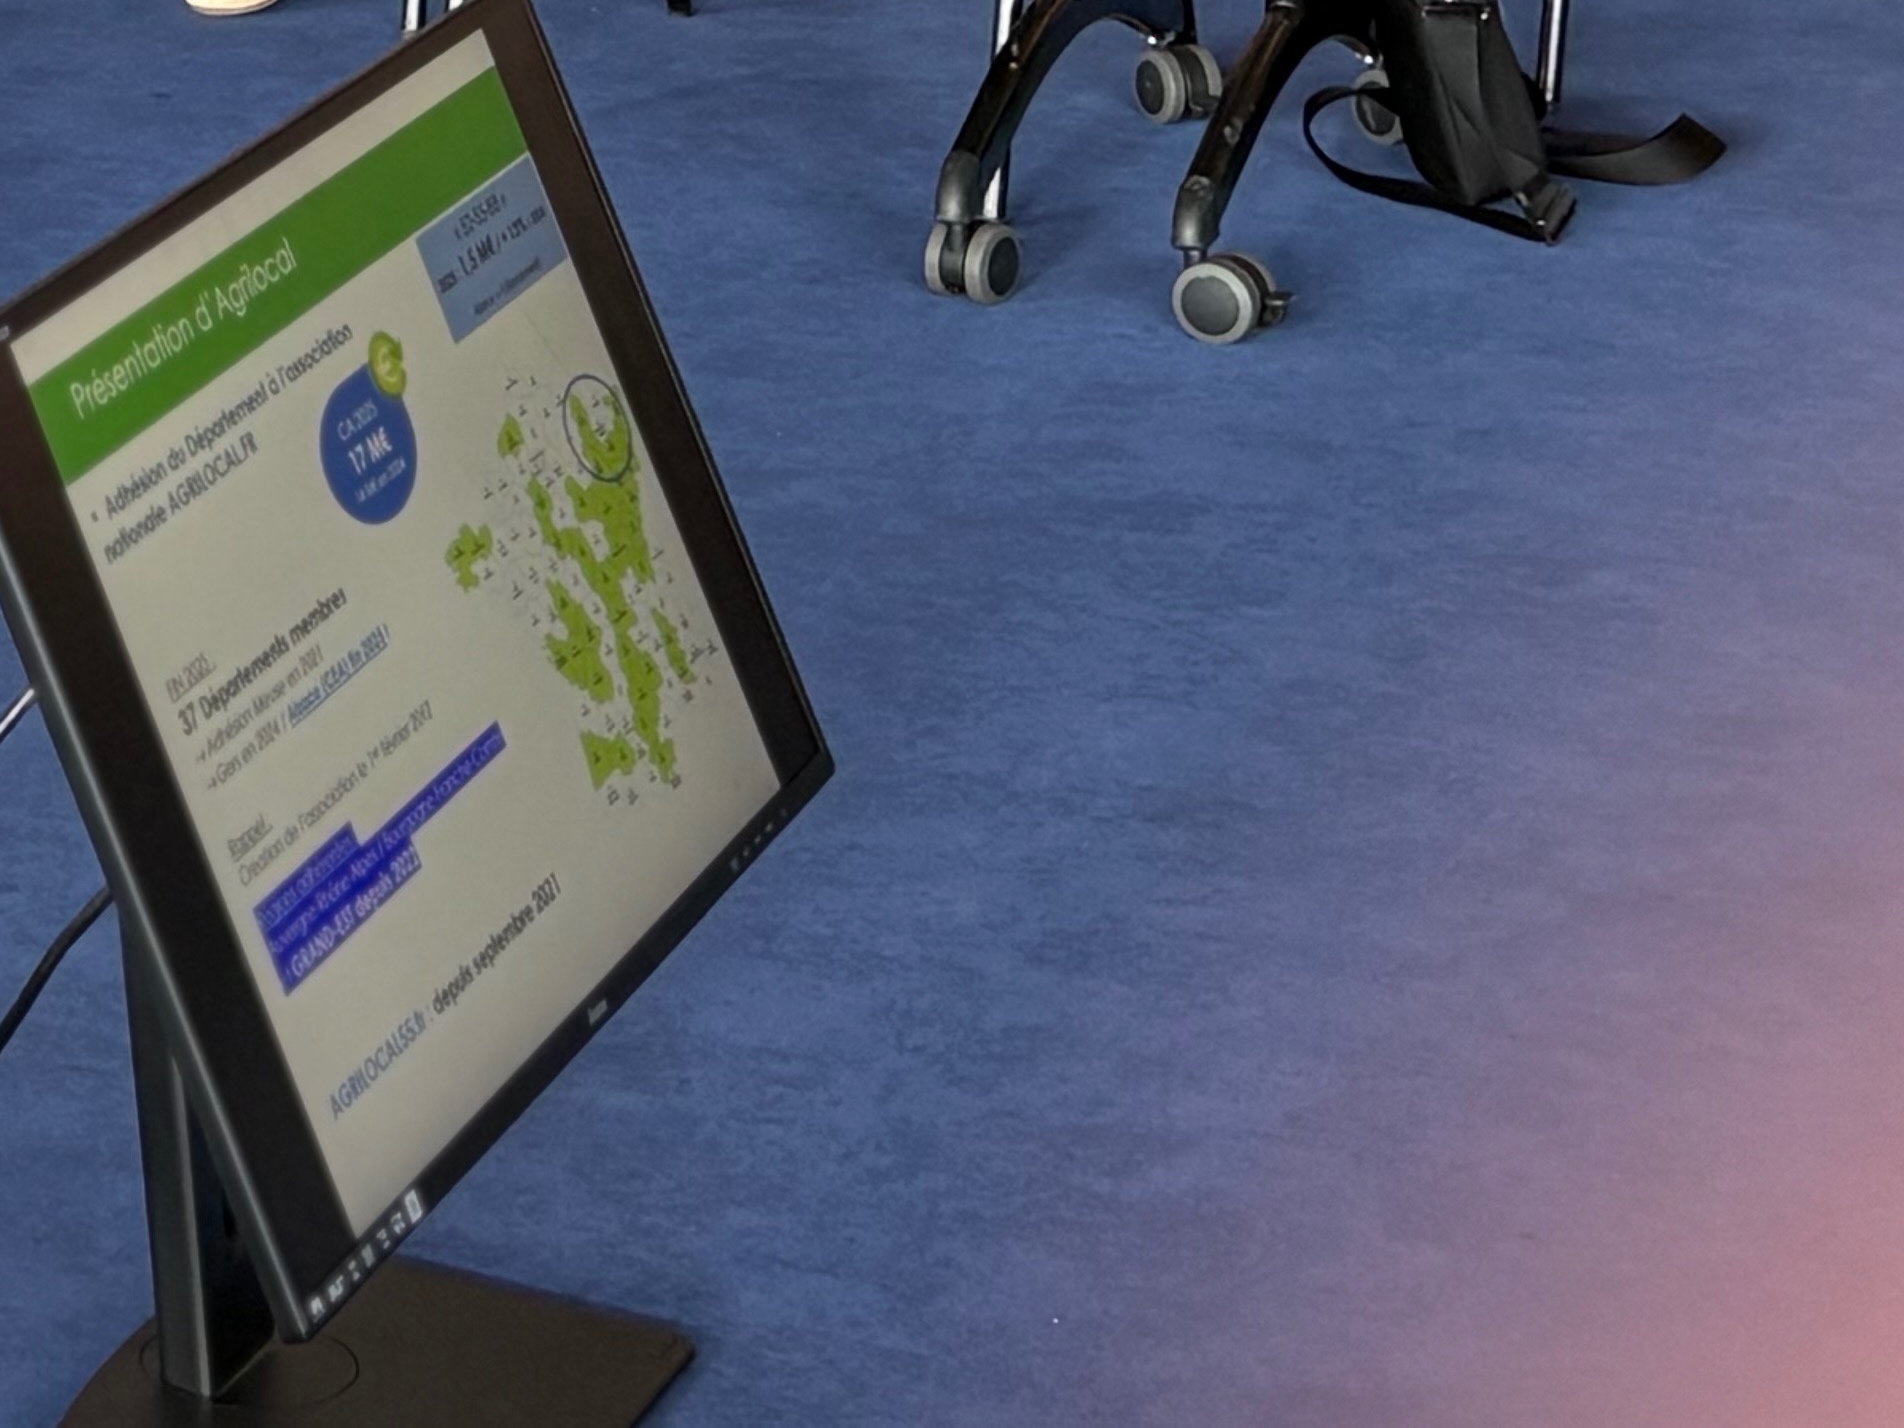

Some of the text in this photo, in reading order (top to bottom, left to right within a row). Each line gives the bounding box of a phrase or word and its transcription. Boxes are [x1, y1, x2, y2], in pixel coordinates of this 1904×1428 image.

[68, 311, 195, 419] Présentation
[347, 442, 368, 475] 17
[176, 700, 199, 737] 37
